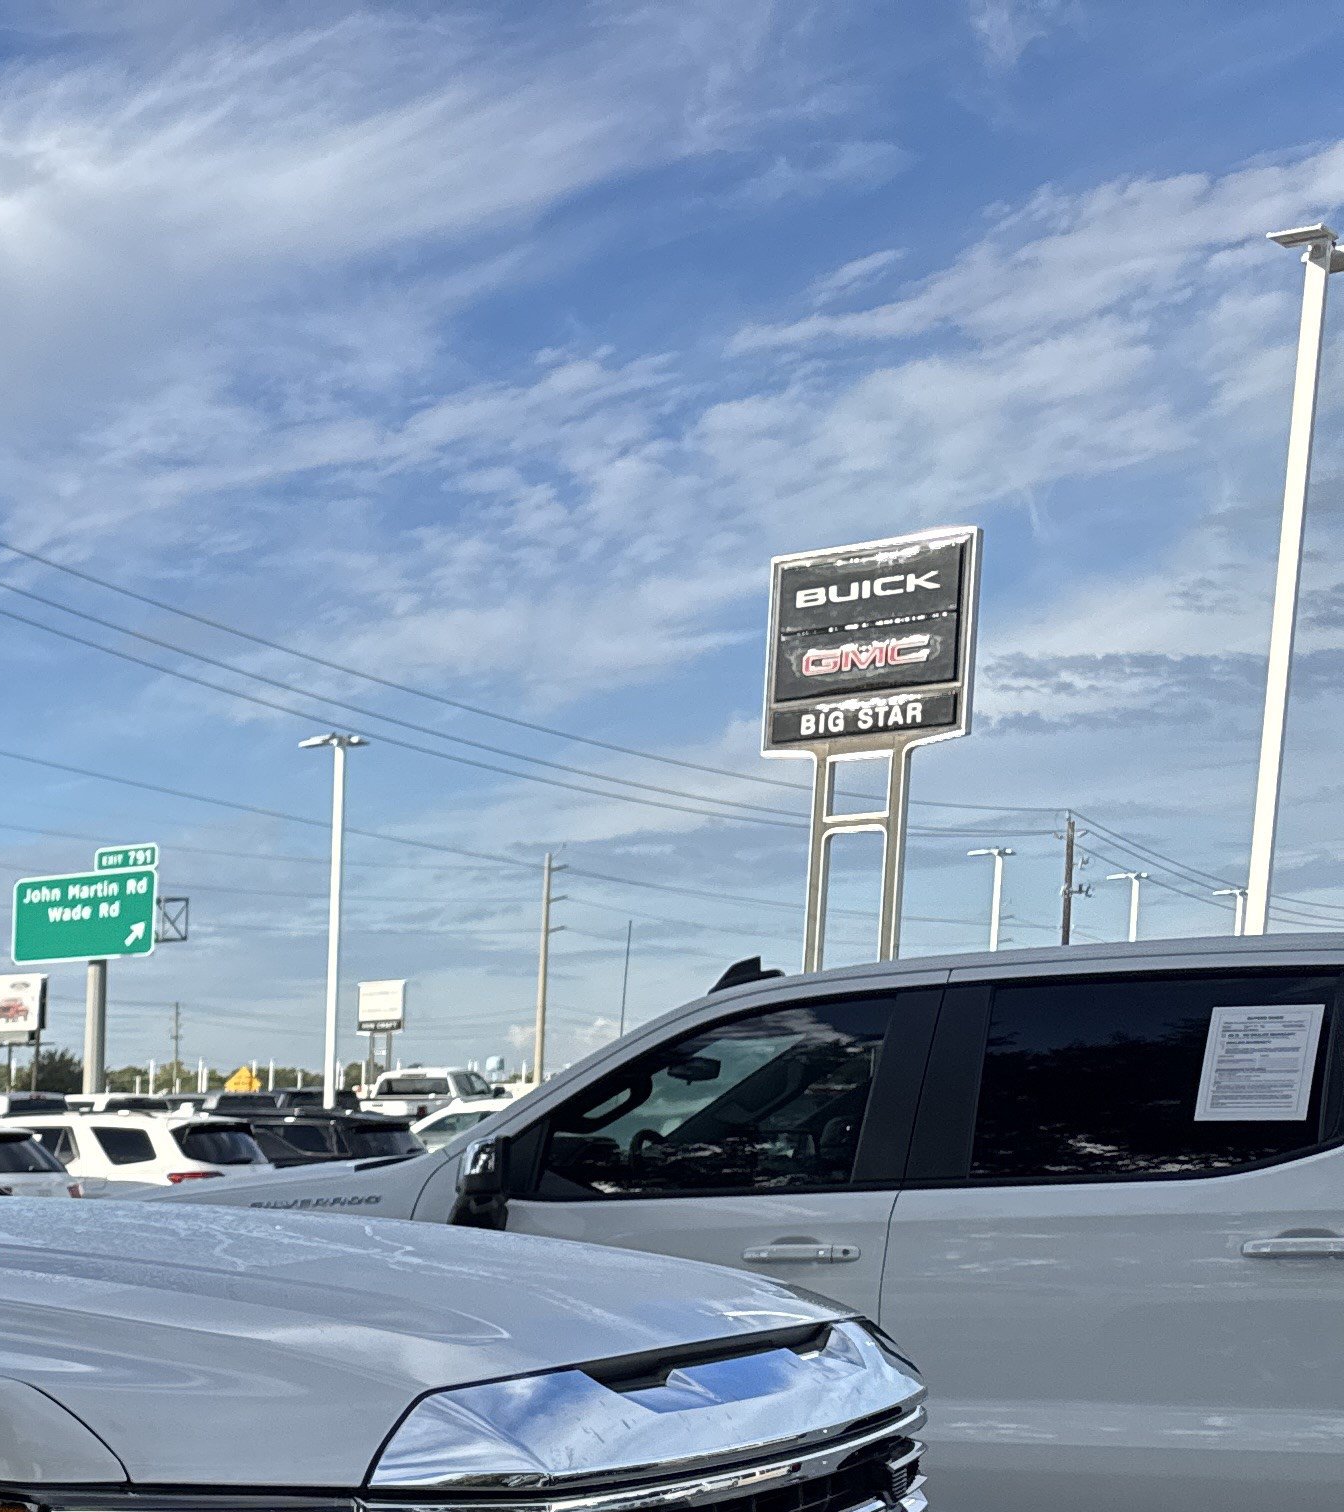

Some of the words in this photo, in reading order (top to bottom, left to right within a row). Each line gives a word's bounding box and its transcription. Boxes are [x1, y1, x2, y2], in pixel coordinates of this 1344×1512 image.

[795, 570, 941, 609] BUICK
[801, 633, 931, 677] GMC
[800, 708, 844, 736] BIG
[857, 702, 923, 730] STAR
[101, 854, 124, 867] EXIT
[127, 849, 152, 866] 791
[23, 886, 61, 904] John
[68, 880, 120, 900] Martin
[126, 876, 148, 895] Rd
[47, 904, 93, 923] Wade
[98, 900, 121, 918] Rd
